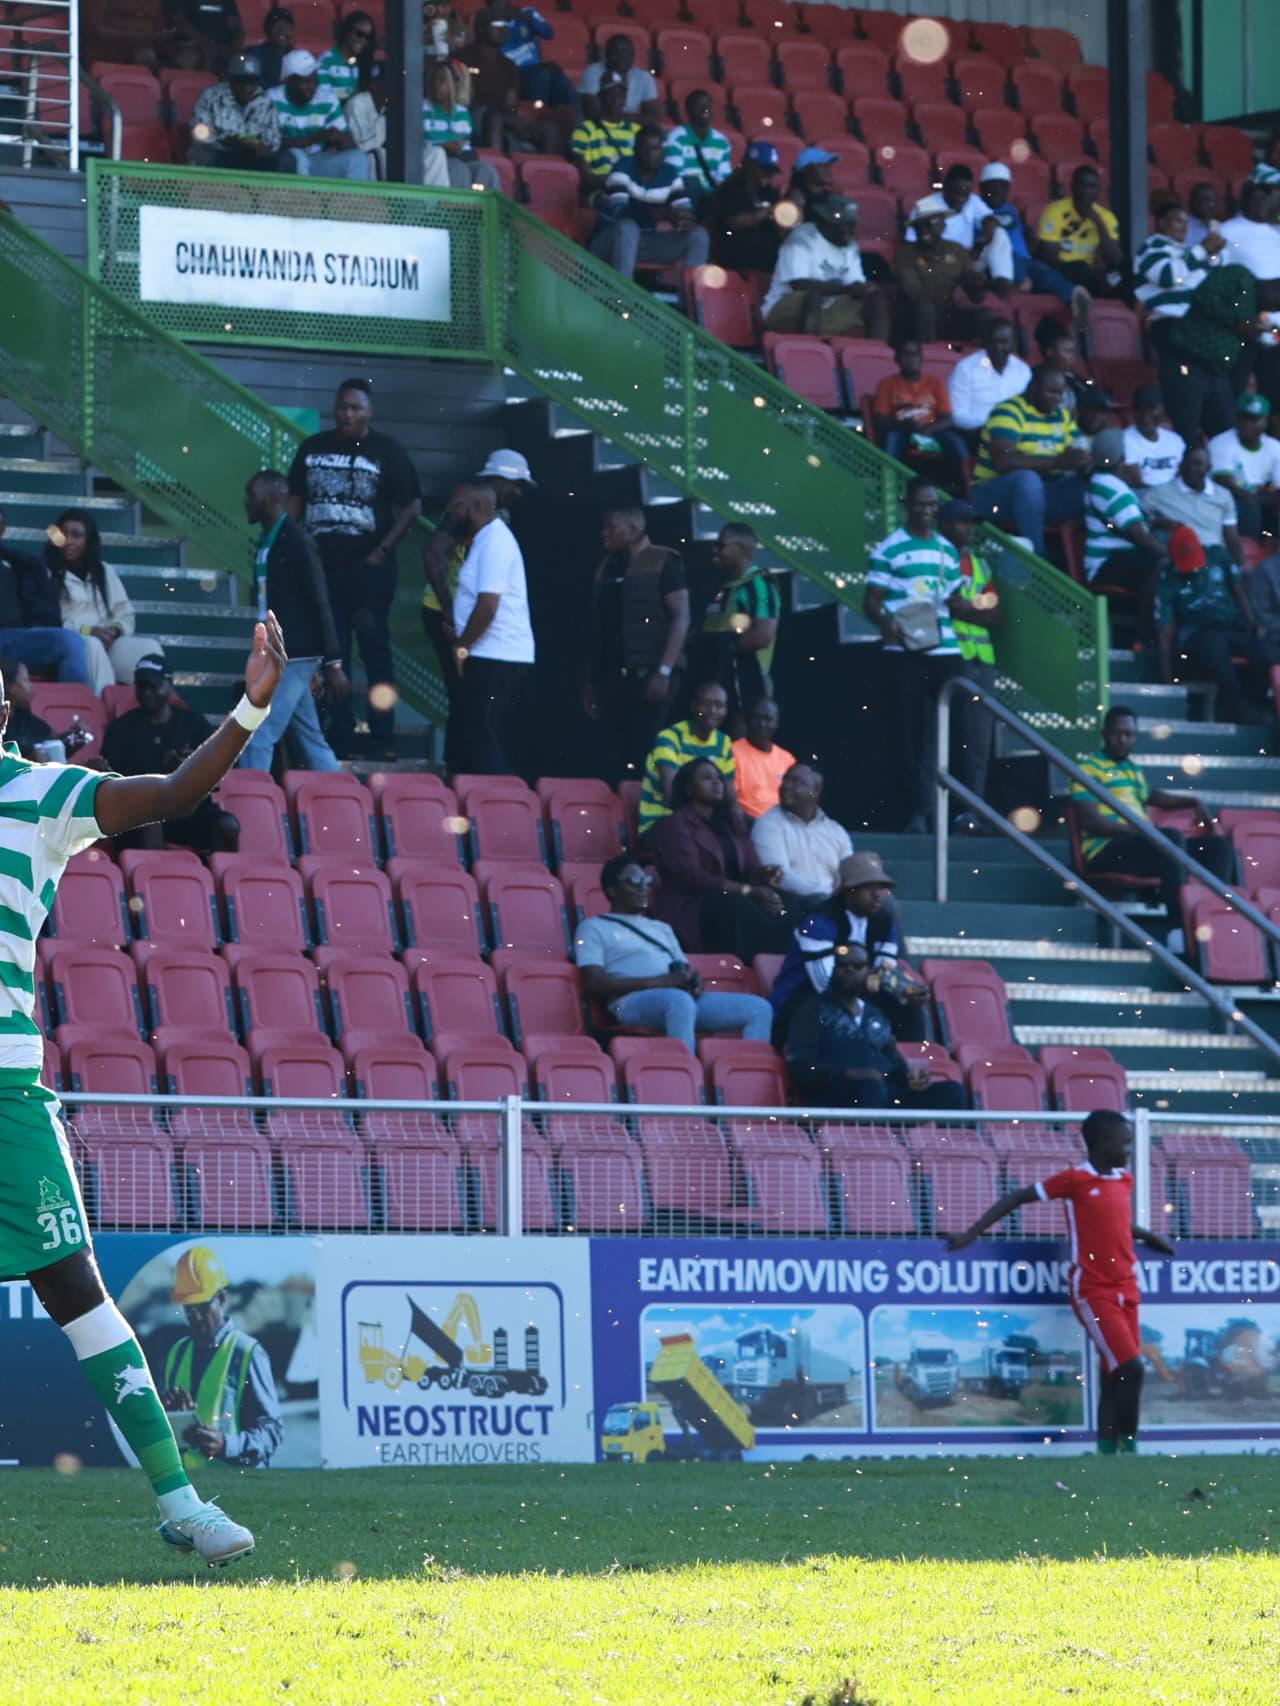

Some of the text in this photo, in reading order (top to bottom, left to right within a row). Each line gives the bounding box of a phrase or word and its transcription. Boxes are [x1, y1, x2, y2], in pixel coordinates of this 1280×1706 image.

[176, 241, 420, 291] CHAHWANDA STADIUM
[36, 1207, 82, 1250] 36
[639, 1257, 889, 1294] EARTHMOVING
[357, 1405, 554, 1436] NEOSTRUCT
[380, 1442, 541, 1464] EARTHMOVERS
